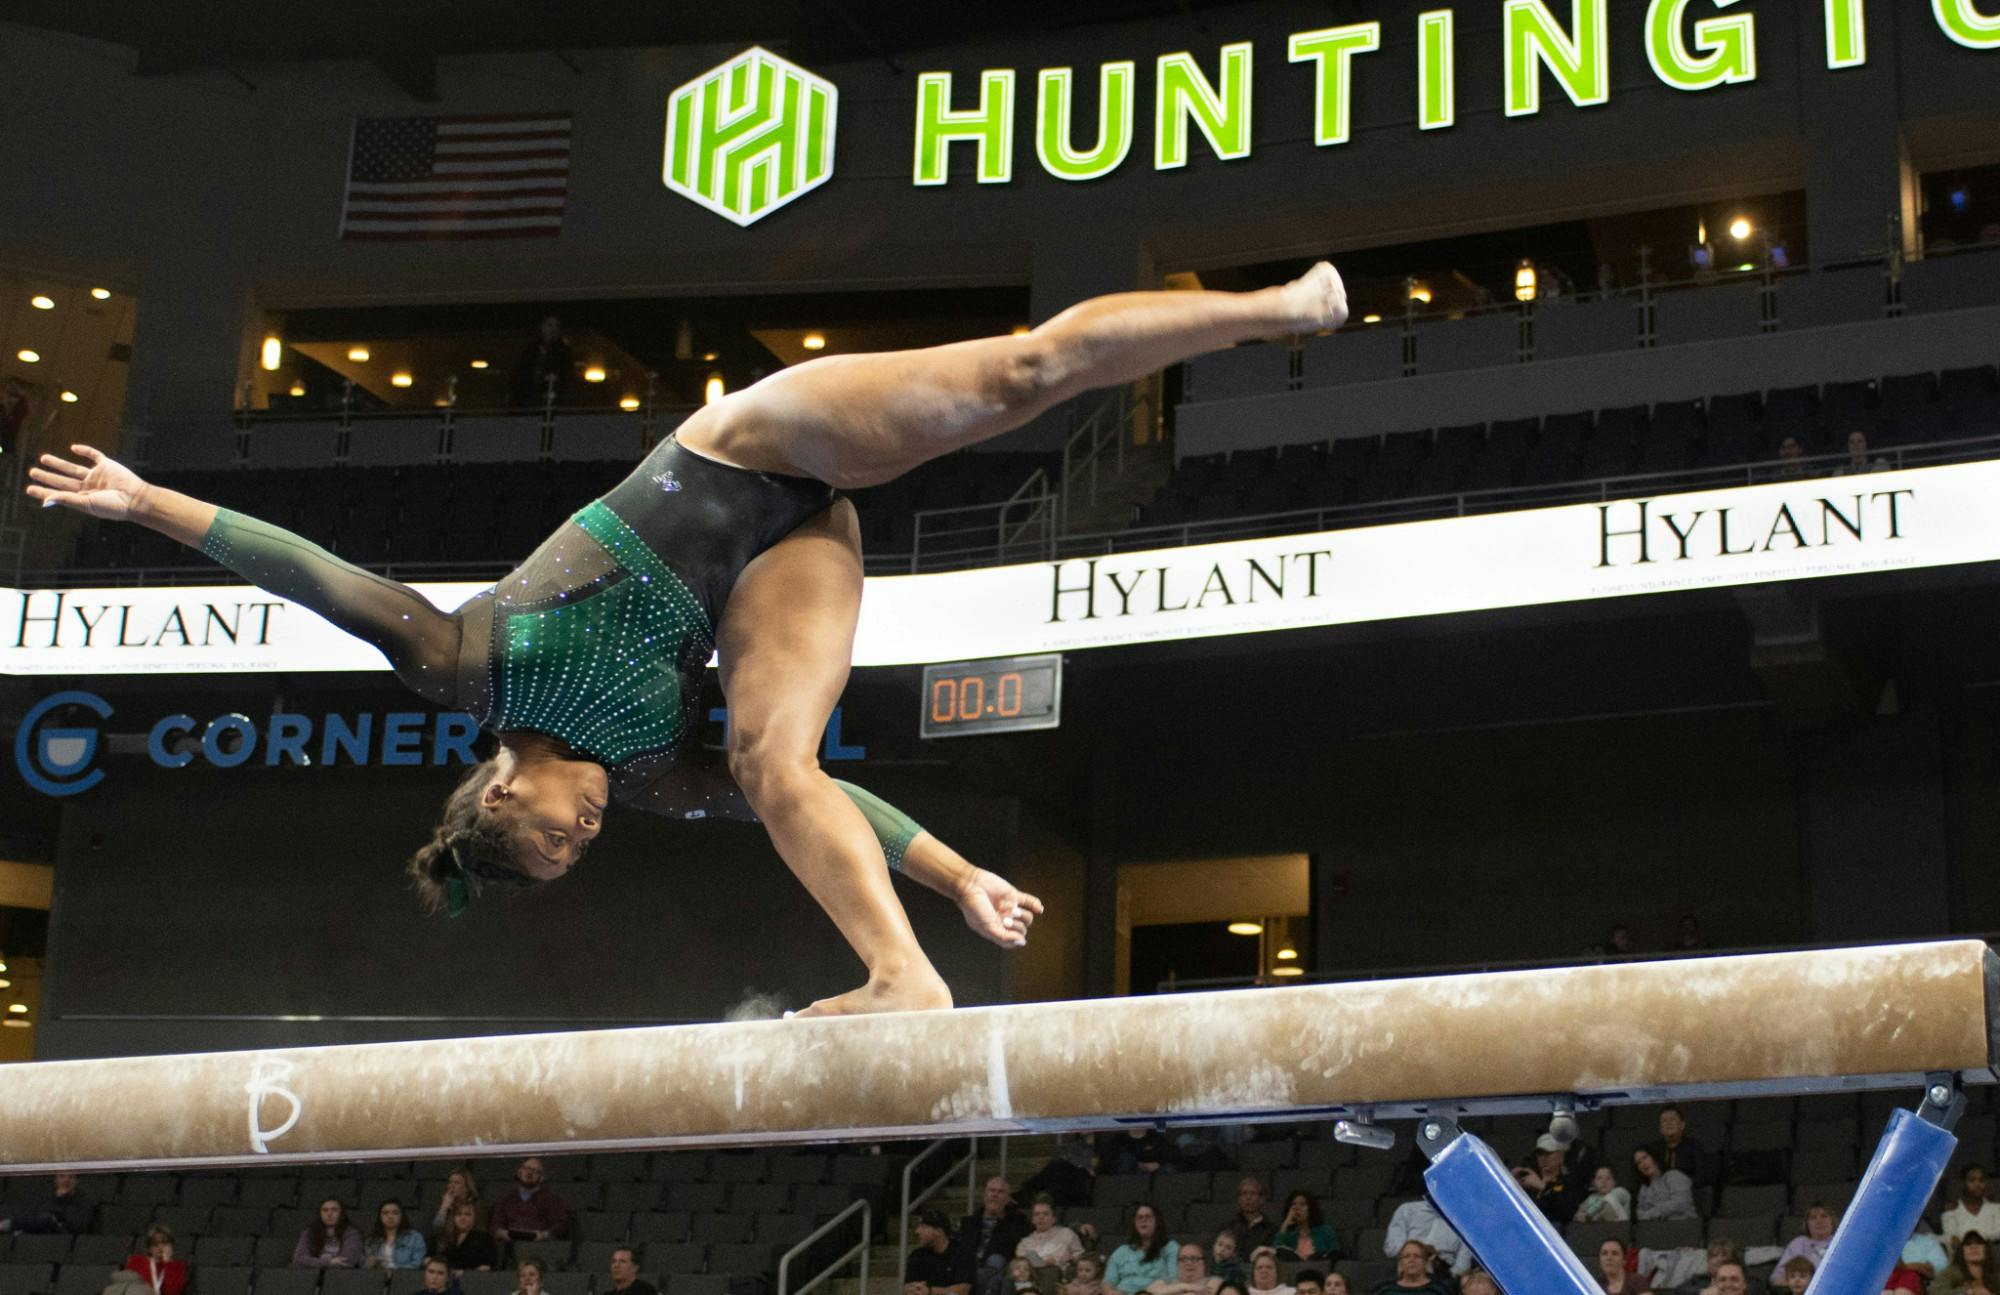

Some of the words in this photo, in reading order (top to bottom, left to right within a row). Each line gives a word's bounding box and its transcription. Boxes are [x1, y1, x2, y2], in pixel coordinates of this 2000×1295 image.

[1591, 490, 1915, 568] HYLANT
[1044, 550, 1331, 624] HYLANT
[9, 589, 286, 648] HYLANT
[932, 672, 1022, 723] 00.0
[147, 711, 480, 769] CORNER
